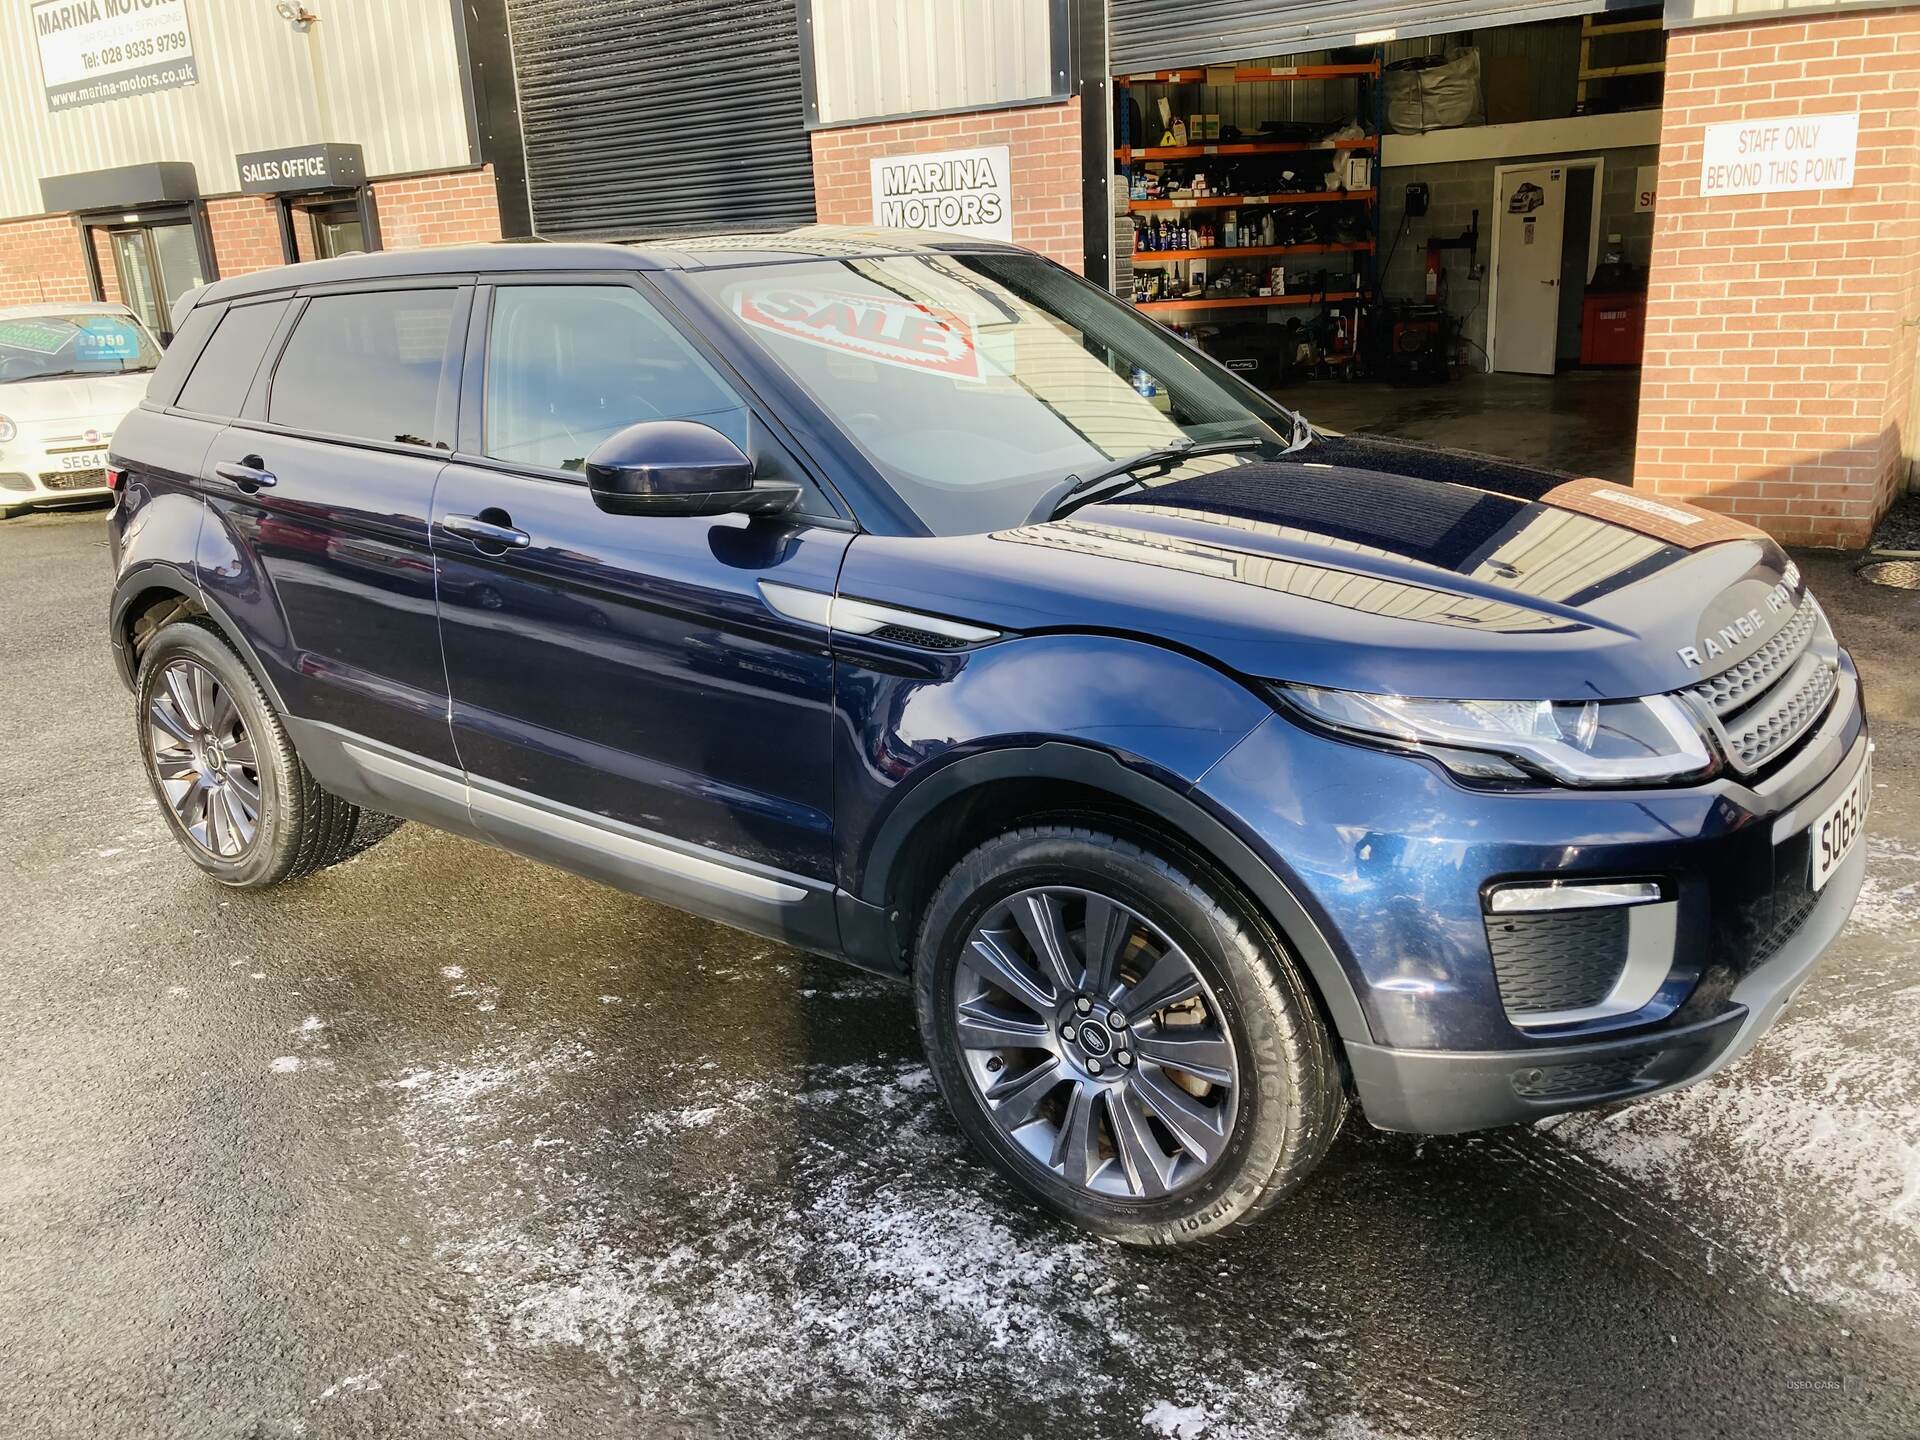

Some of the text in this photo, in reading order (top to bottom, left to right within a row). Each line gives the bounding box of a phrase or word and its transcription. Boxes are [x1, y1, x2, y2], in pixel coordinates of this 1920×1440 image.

[38, 0, 100, 36] MARINA
[81, 31, 186, 70] Tel: 028 9335 9799
[50, 63, 194, 107] www.marina-motors.co.uk
[1738, 125, 1821, 154] STAFF ONLY
[242, 156, 326, 182] SALES OFFICE
[882, 157, 998, 196] MARINA
[1707, 156, 1847, 189] BEYOND THIS POINT
[881, 192, 1002, 229] MOTORS
[761, 290, 952, 358] SALE
[1676, 608, 1766, 670] RANGE
[1179, 1195, 1234, 1234] HP801
